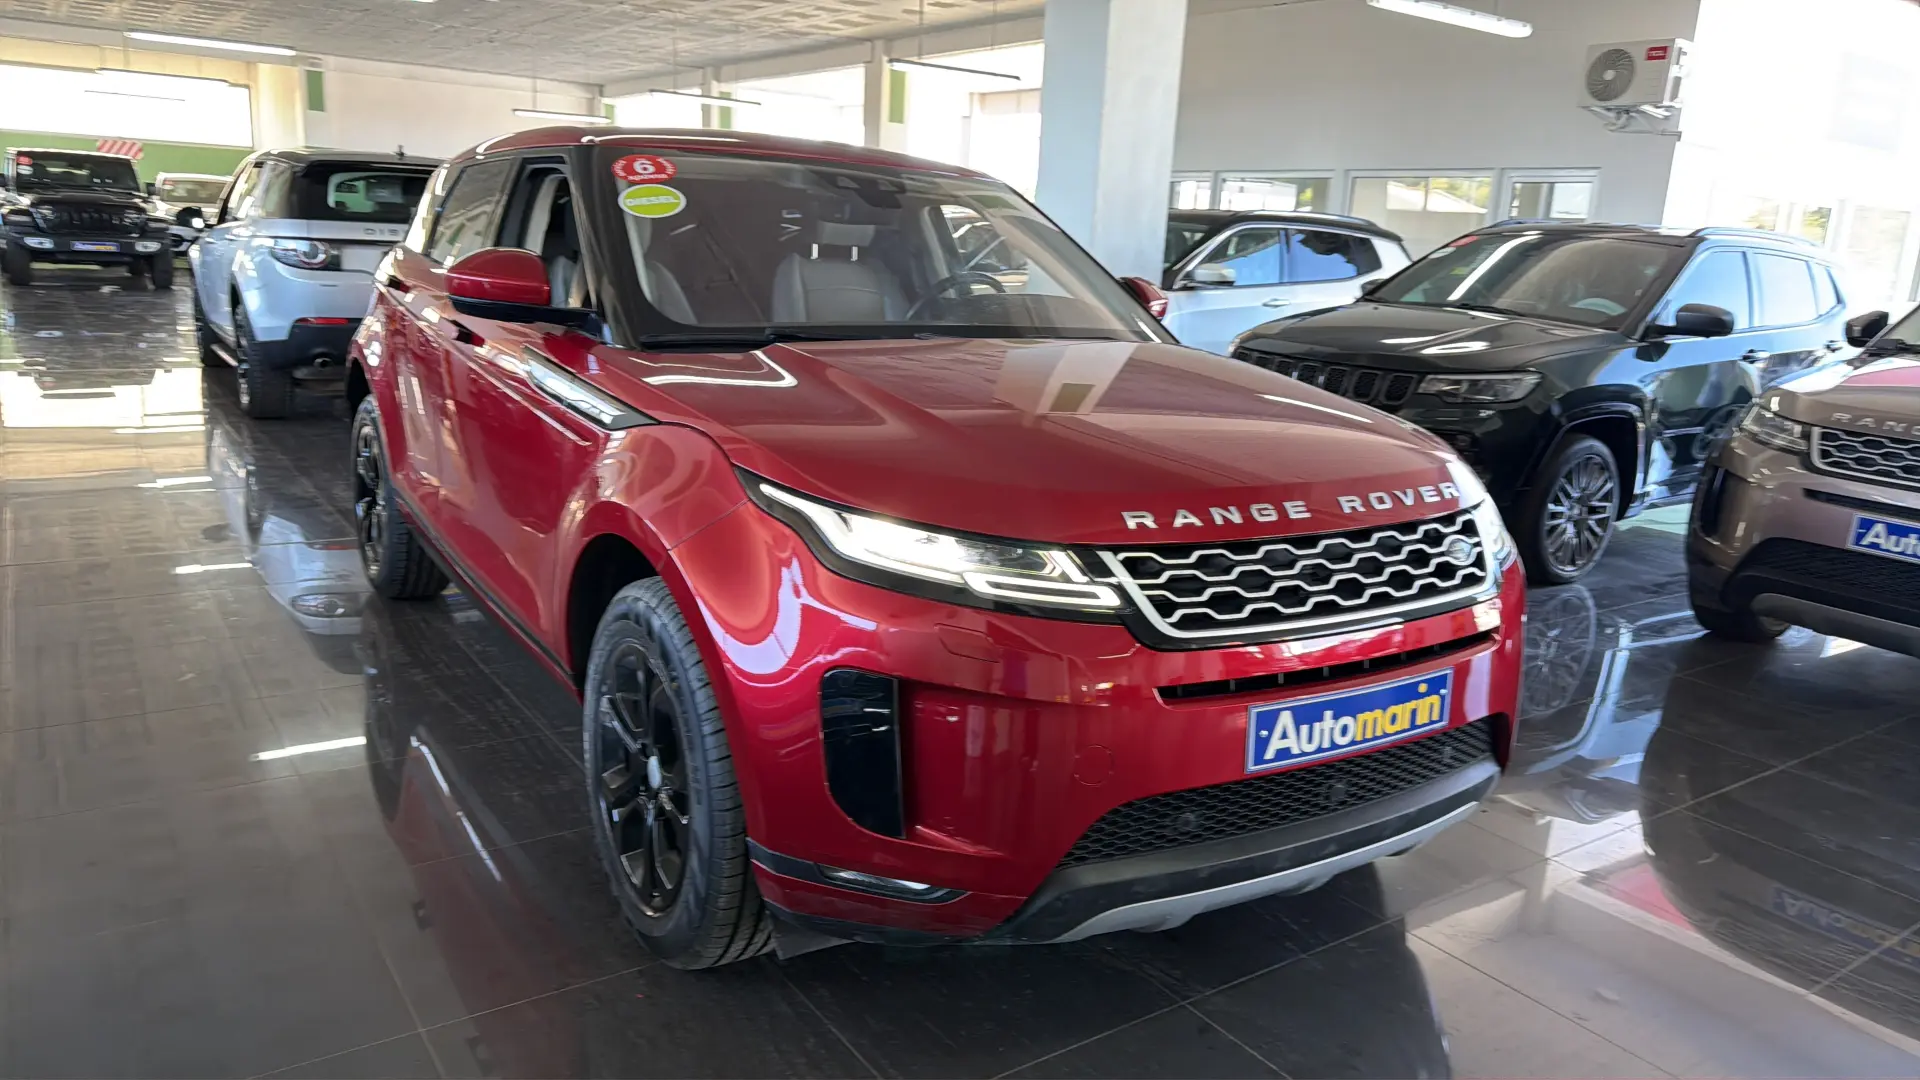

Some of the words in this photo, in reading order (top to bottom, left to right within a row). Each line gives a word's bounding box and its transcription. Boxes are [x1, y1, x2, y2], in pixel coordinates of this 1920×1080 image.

[633, 160, 656, 174] 6
[1121, 500, 1312, 530] RANGE
[1337, 481, 1459, 514] ROVER
[1262, 683, 1442, 761] Automarin
